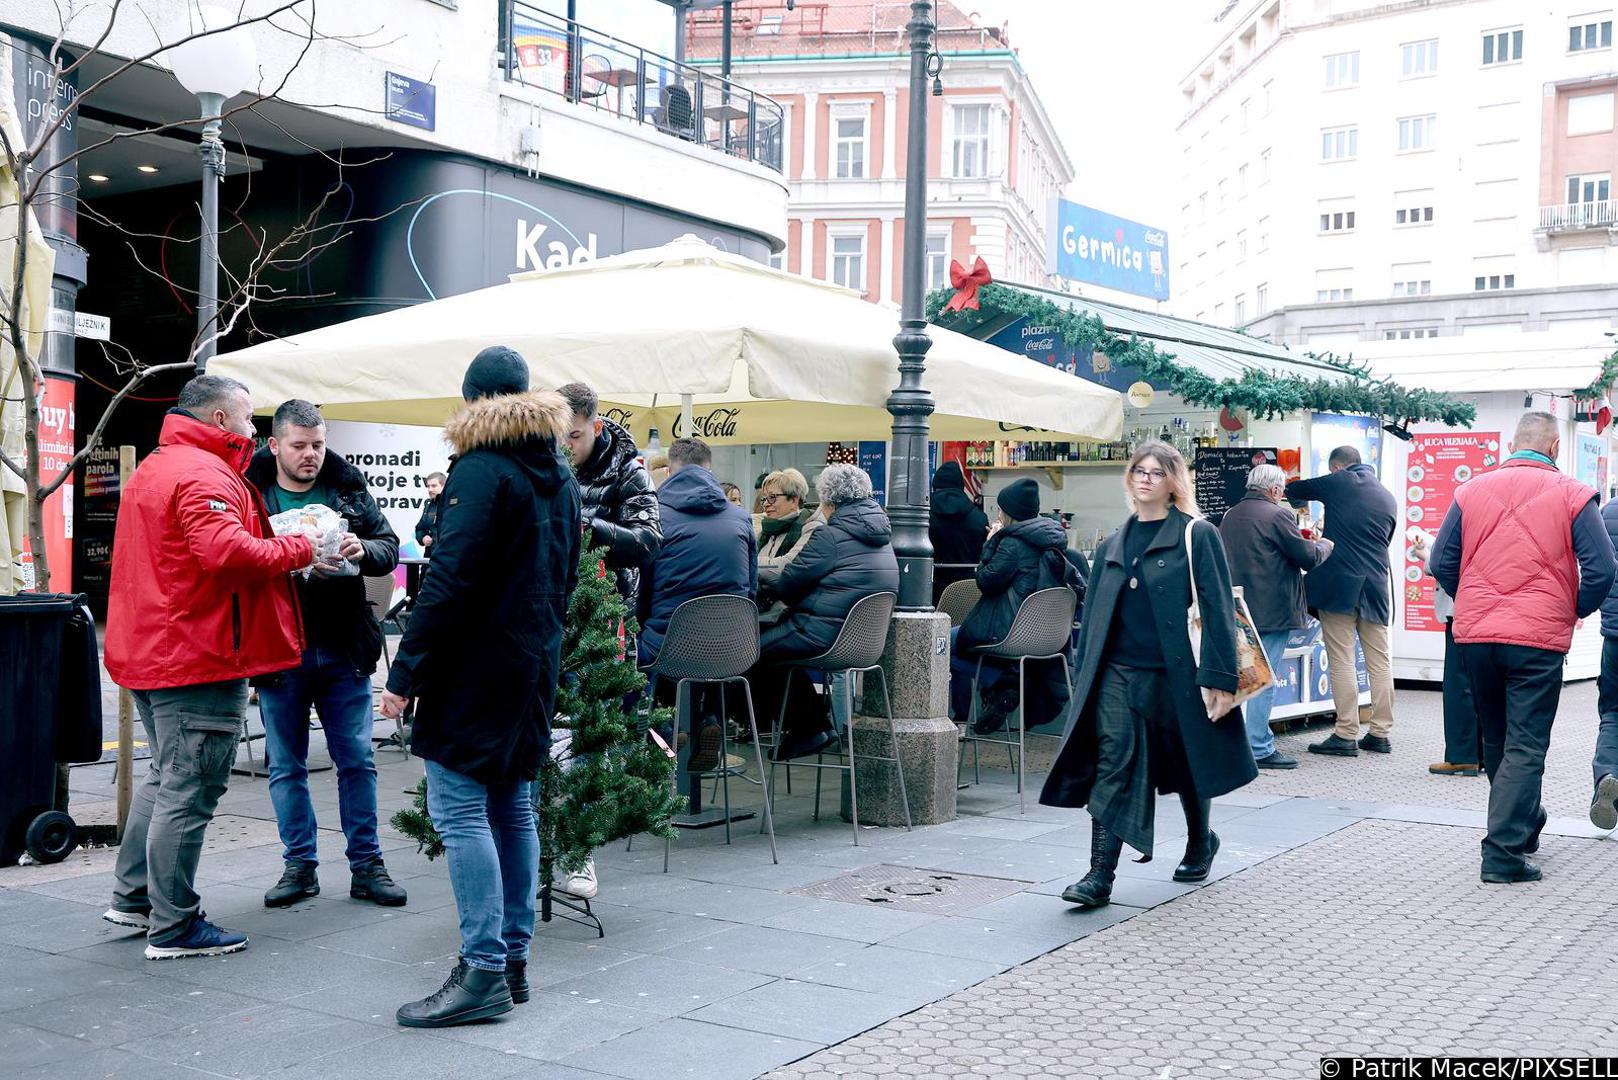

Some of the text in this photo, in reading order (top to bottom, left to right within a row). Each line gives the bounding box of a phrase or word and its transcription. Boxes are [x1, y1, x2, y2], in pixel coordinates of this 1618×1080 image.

[516, 219, 598, 273] Kad
[1061, 224, 1143, 273] Germica
[345, 450, 421, 467] pronađi
[364, 471, 408, 491] koje
